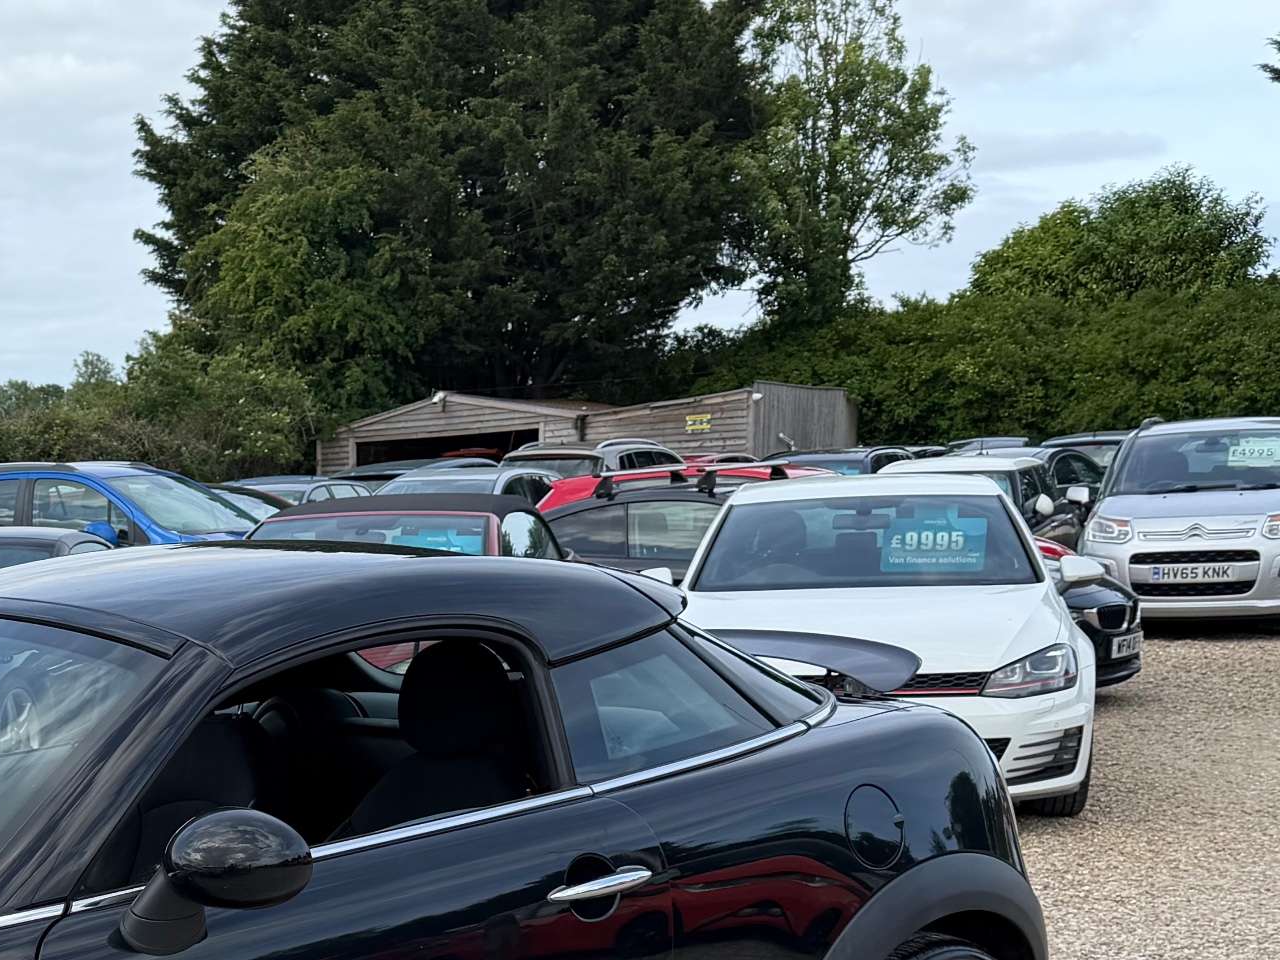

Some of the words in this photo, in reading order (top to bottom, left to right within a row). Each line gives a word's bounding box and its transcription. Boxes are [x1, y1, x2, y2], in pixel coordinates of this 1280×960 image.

[890, 531, 964, 550] £9995
[1161, 568, 1199, 579] HV65
[1202, 567, 1230, 578] KNK
